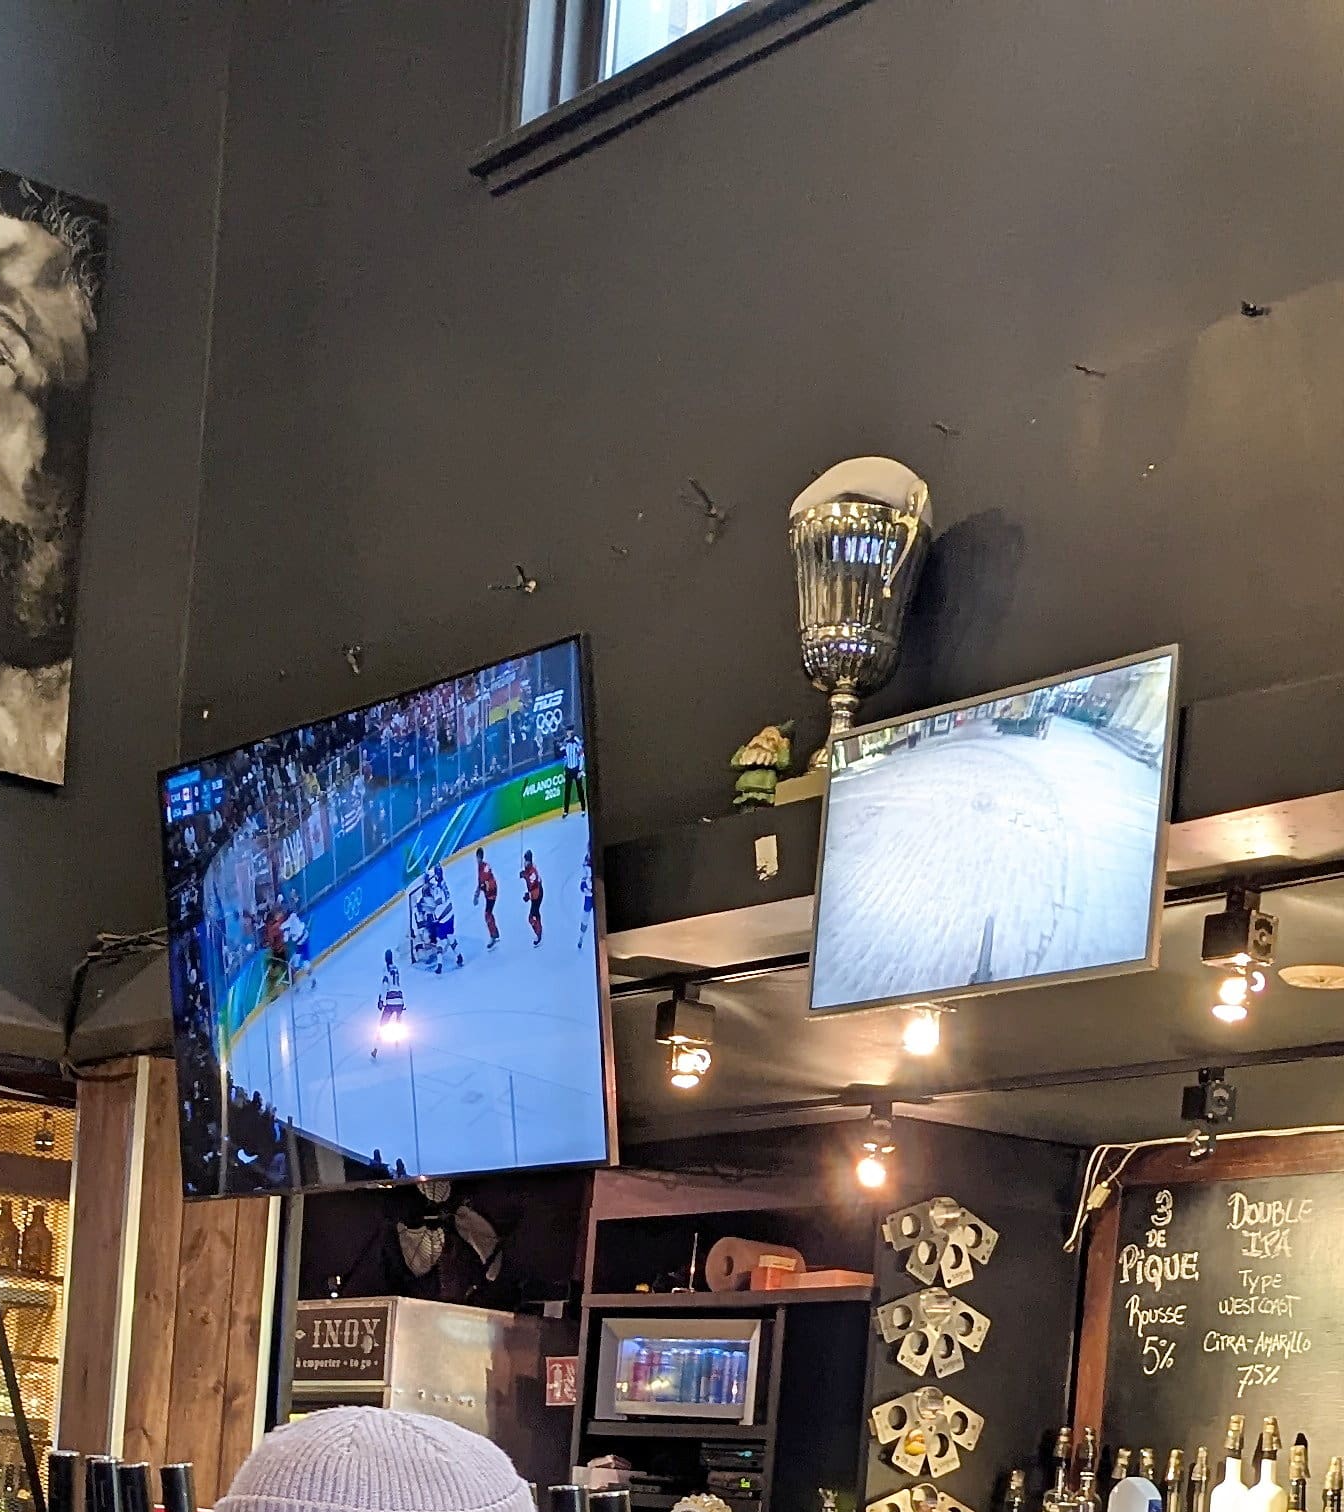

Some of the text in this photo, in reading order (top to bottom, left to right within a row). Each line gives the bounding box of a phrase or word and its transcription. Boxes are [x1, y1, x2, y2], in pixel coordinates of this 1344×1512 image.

[1151, 1189, 1173, 1227] 3
[1227, 1191, 1313, 1230] DOUBLE
[1145, 1229, 1167, 1248] DE
[1241, 1229, 1293, 1259] IPA
[312, 1318, 381, 1348] INOX
[1125, 1294, 1188, 1338] ROUSSE
[1142, 1336, 1176, 1376] 5%
